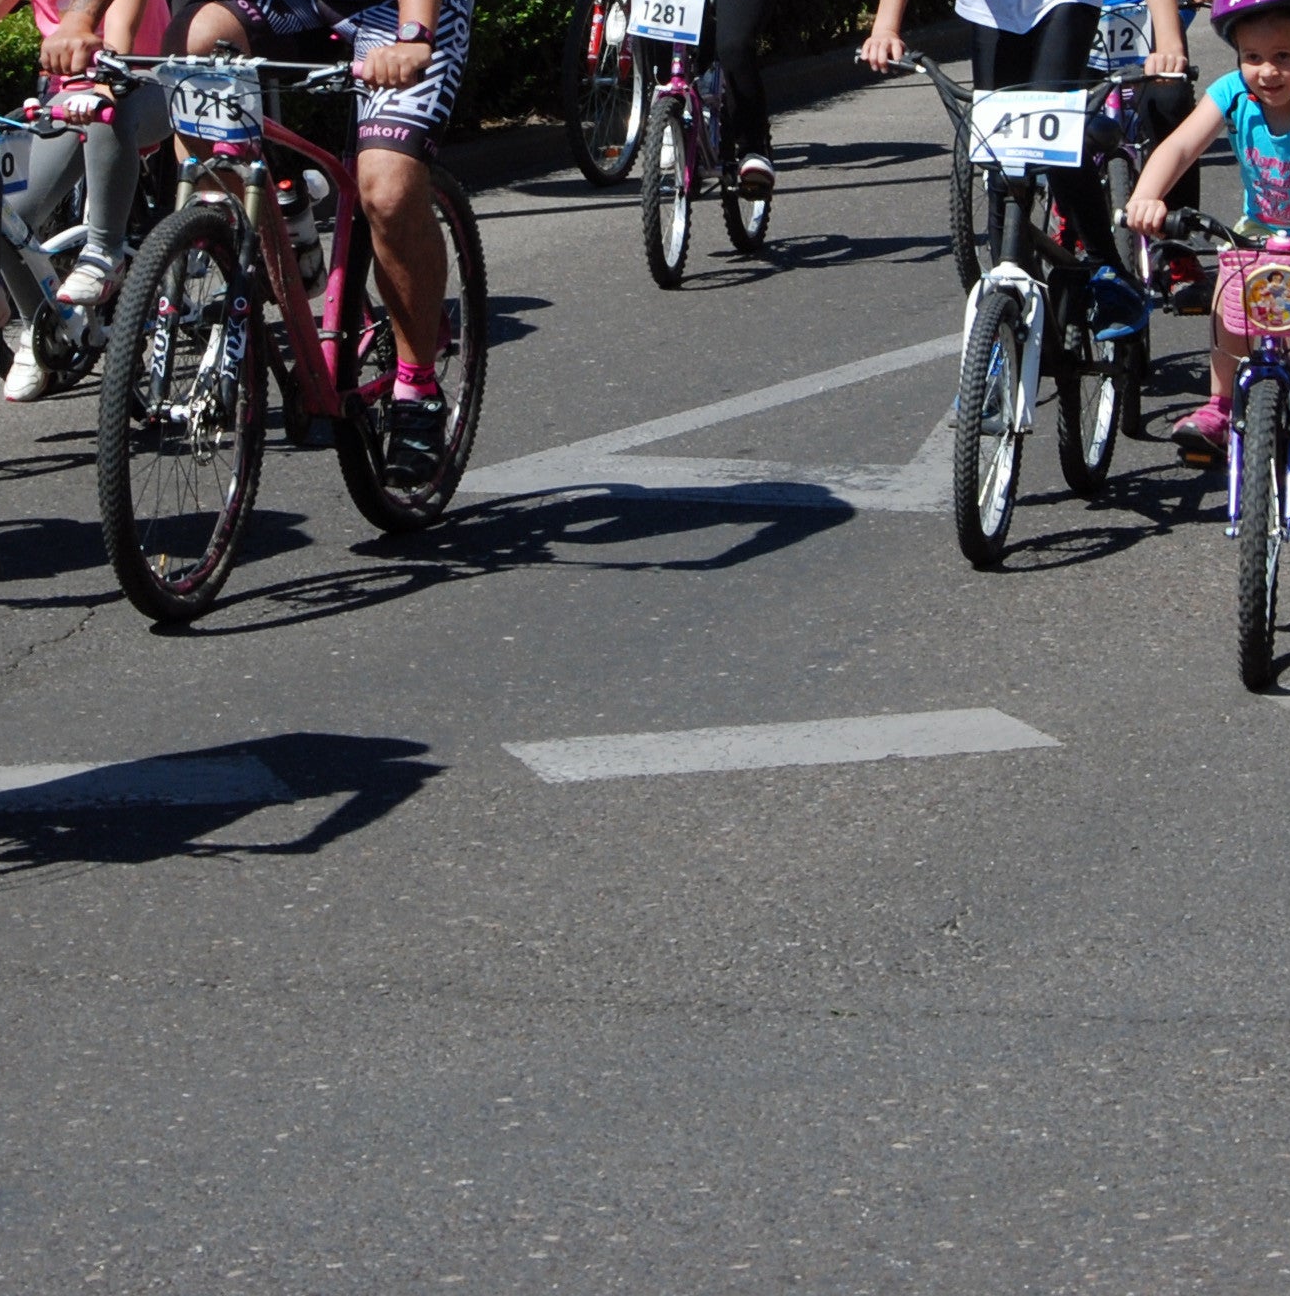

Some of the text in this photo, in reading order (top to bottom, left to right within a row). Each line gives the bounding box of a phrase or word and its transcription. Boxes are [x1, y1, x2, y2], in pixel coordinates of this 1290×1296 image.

[643, 0, 685, 27] 1281
[176, 88, 243, 122] 1215
[359, 123, 410, 142] Tinkoff
[993, 112, 1060, 141] 410
